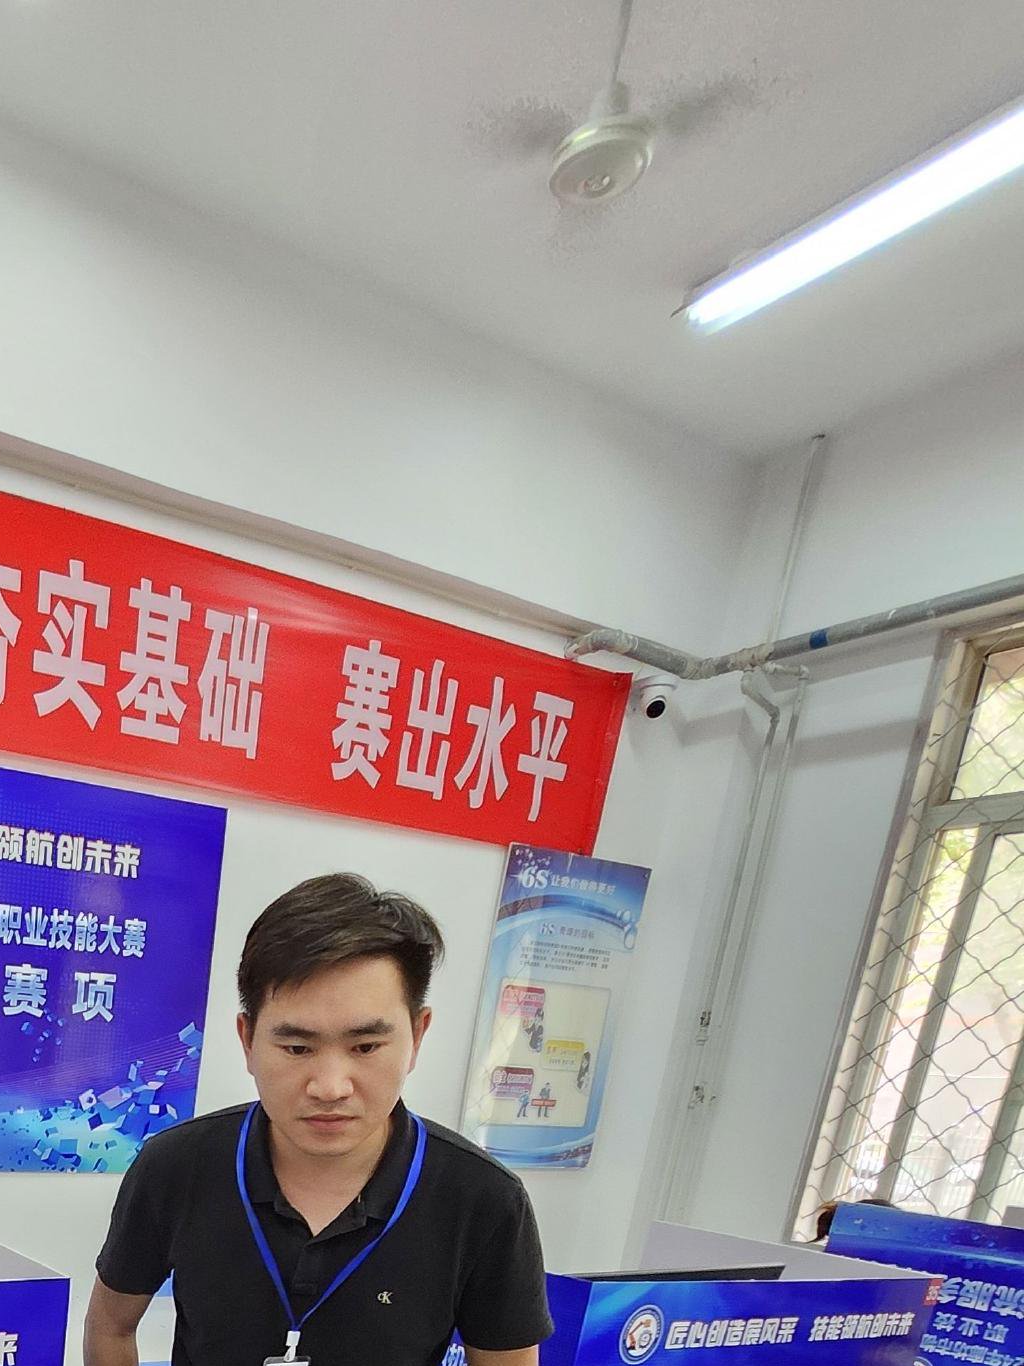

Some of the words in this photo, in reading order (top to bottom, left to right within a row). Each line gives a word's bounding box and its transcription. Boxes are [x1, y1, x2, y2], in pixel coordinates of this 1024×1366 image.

[330, 638, 575, 823] 赛出水平
[664, 1317, 799, 1350] 匠心创造展风采
[808, 1312, 916, 1342] 技能领航创未来
